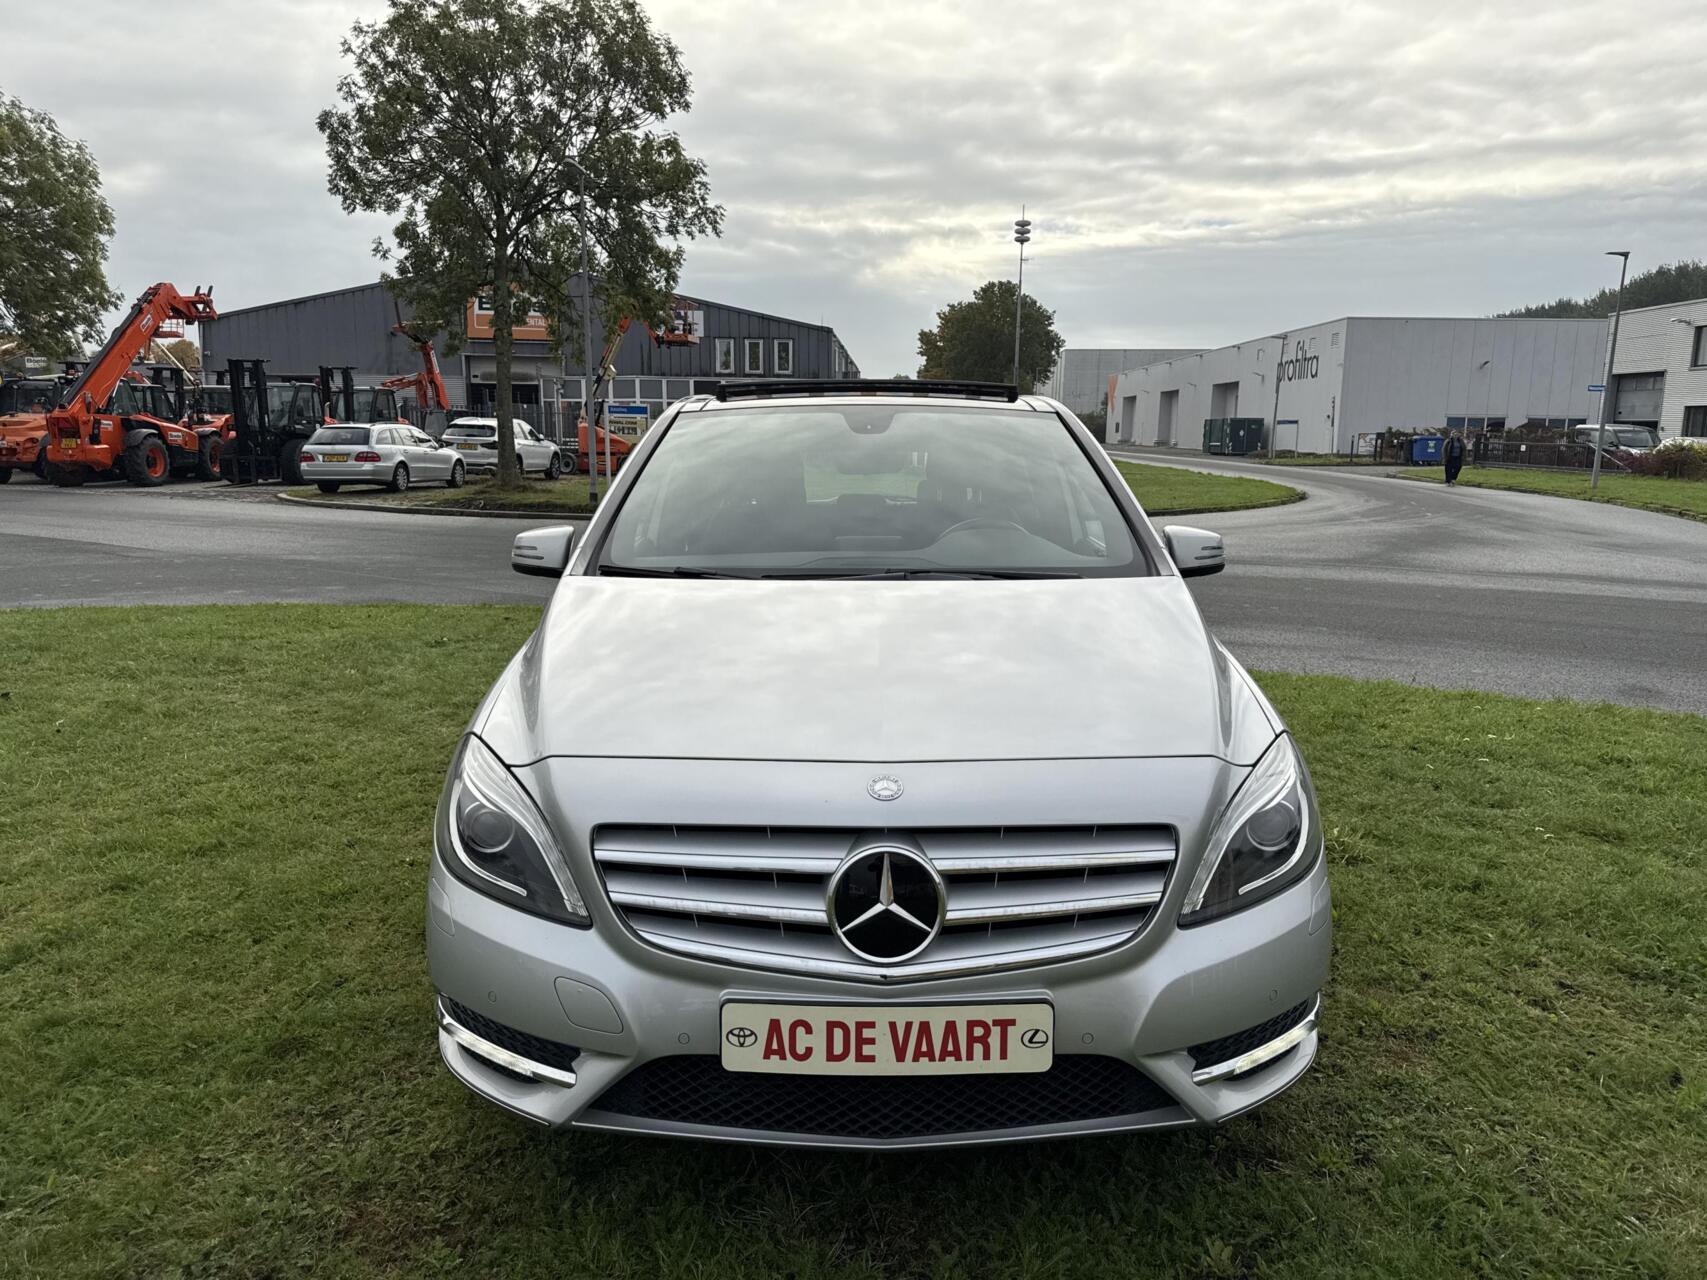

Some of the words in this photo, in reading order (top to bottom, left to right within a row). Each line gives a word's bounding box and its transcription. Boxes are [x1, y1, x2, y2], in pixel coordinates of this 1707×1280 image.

[1276, 339, 1319, 385] profiltra
[763, 1018, 814, 1062] AC
[826, 1020, 877, 1063] DE
[888, 1018, 1017, 1063] VAART
